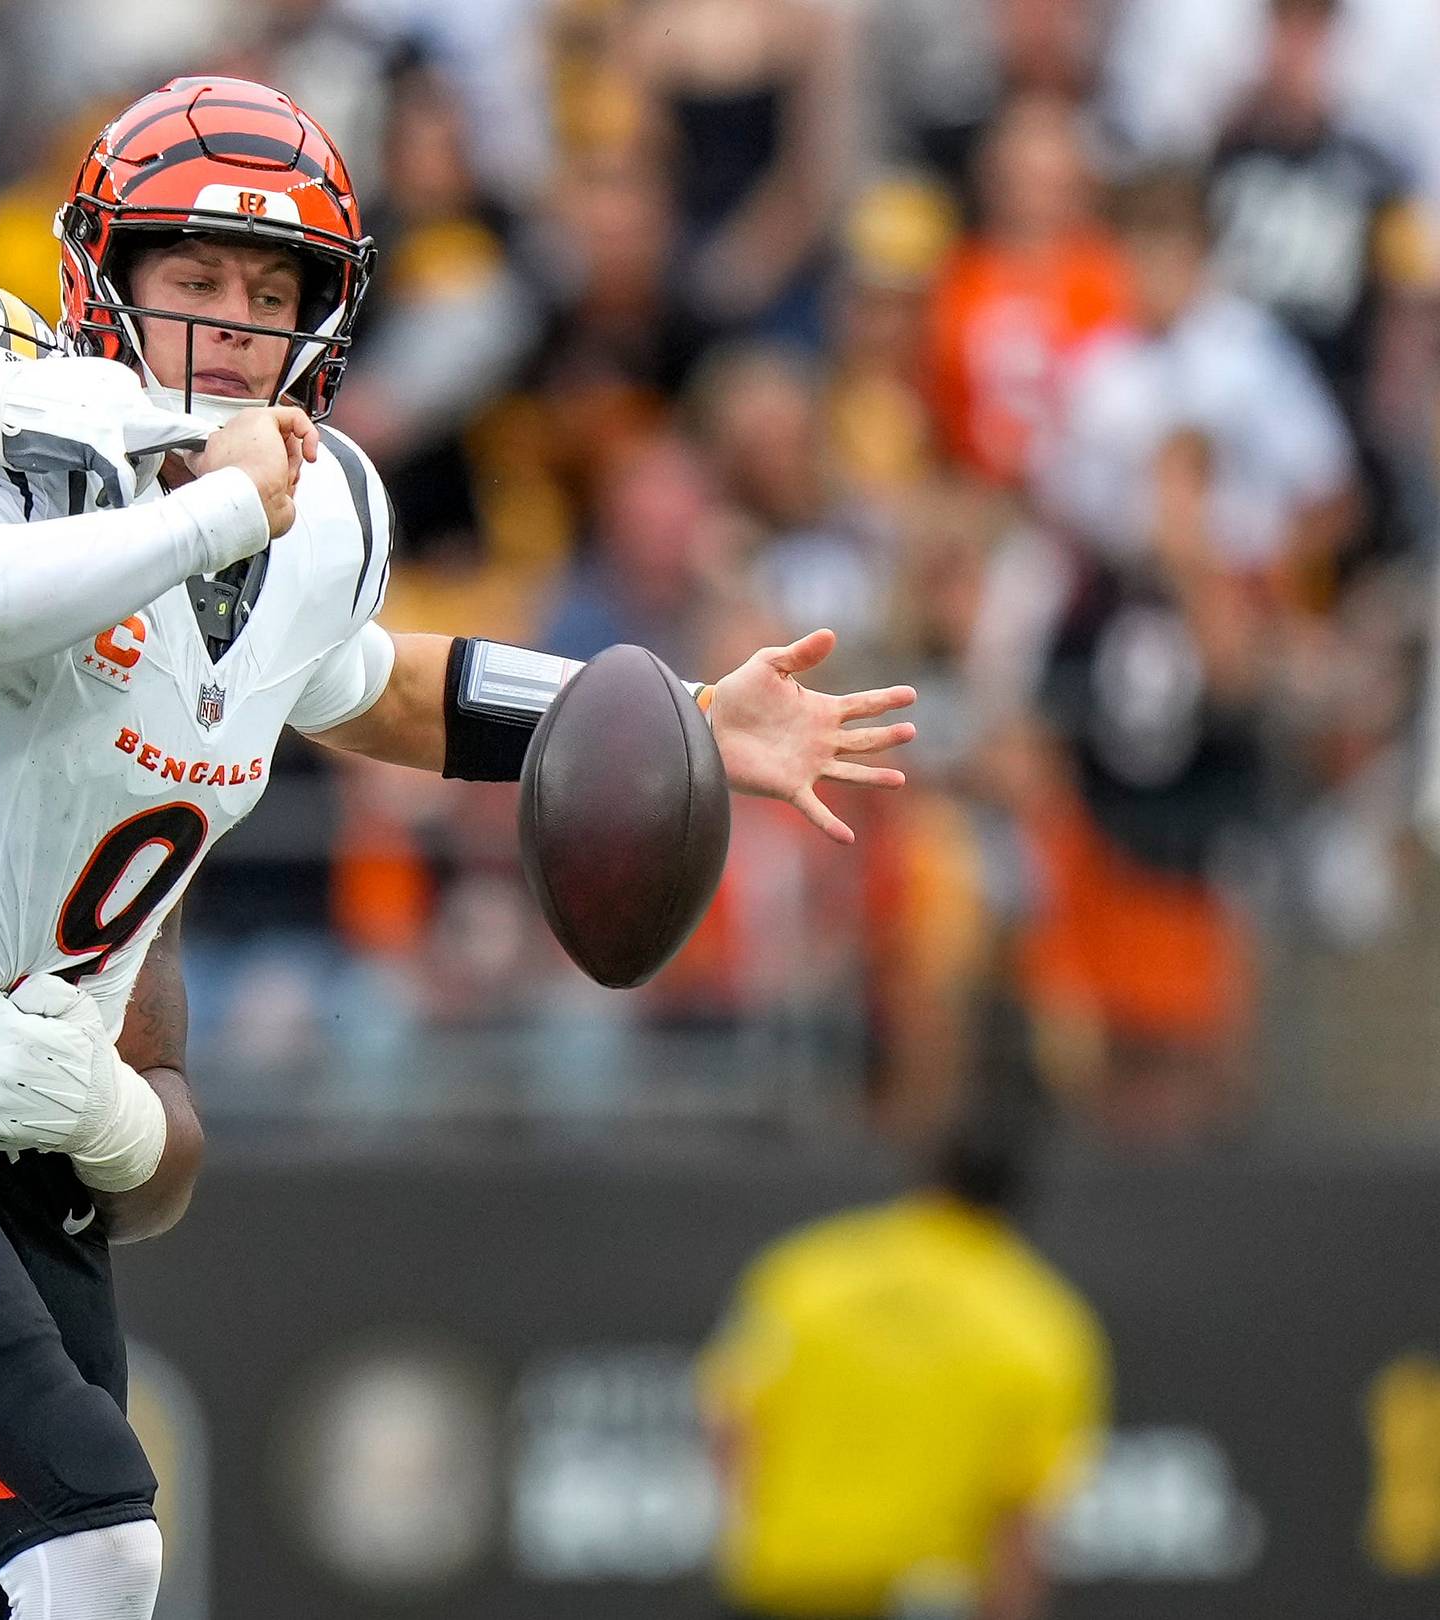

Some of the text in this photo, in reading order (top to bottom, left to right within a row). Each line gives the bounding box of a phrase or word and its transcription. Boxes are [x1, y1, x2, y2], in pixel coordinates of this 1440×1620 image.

[94, 614, 146, 668] C
[200, 700, 220, 721] NFL
[114, 727, 263, 787] BENGALS
[50, 801, 209, 986] 9
